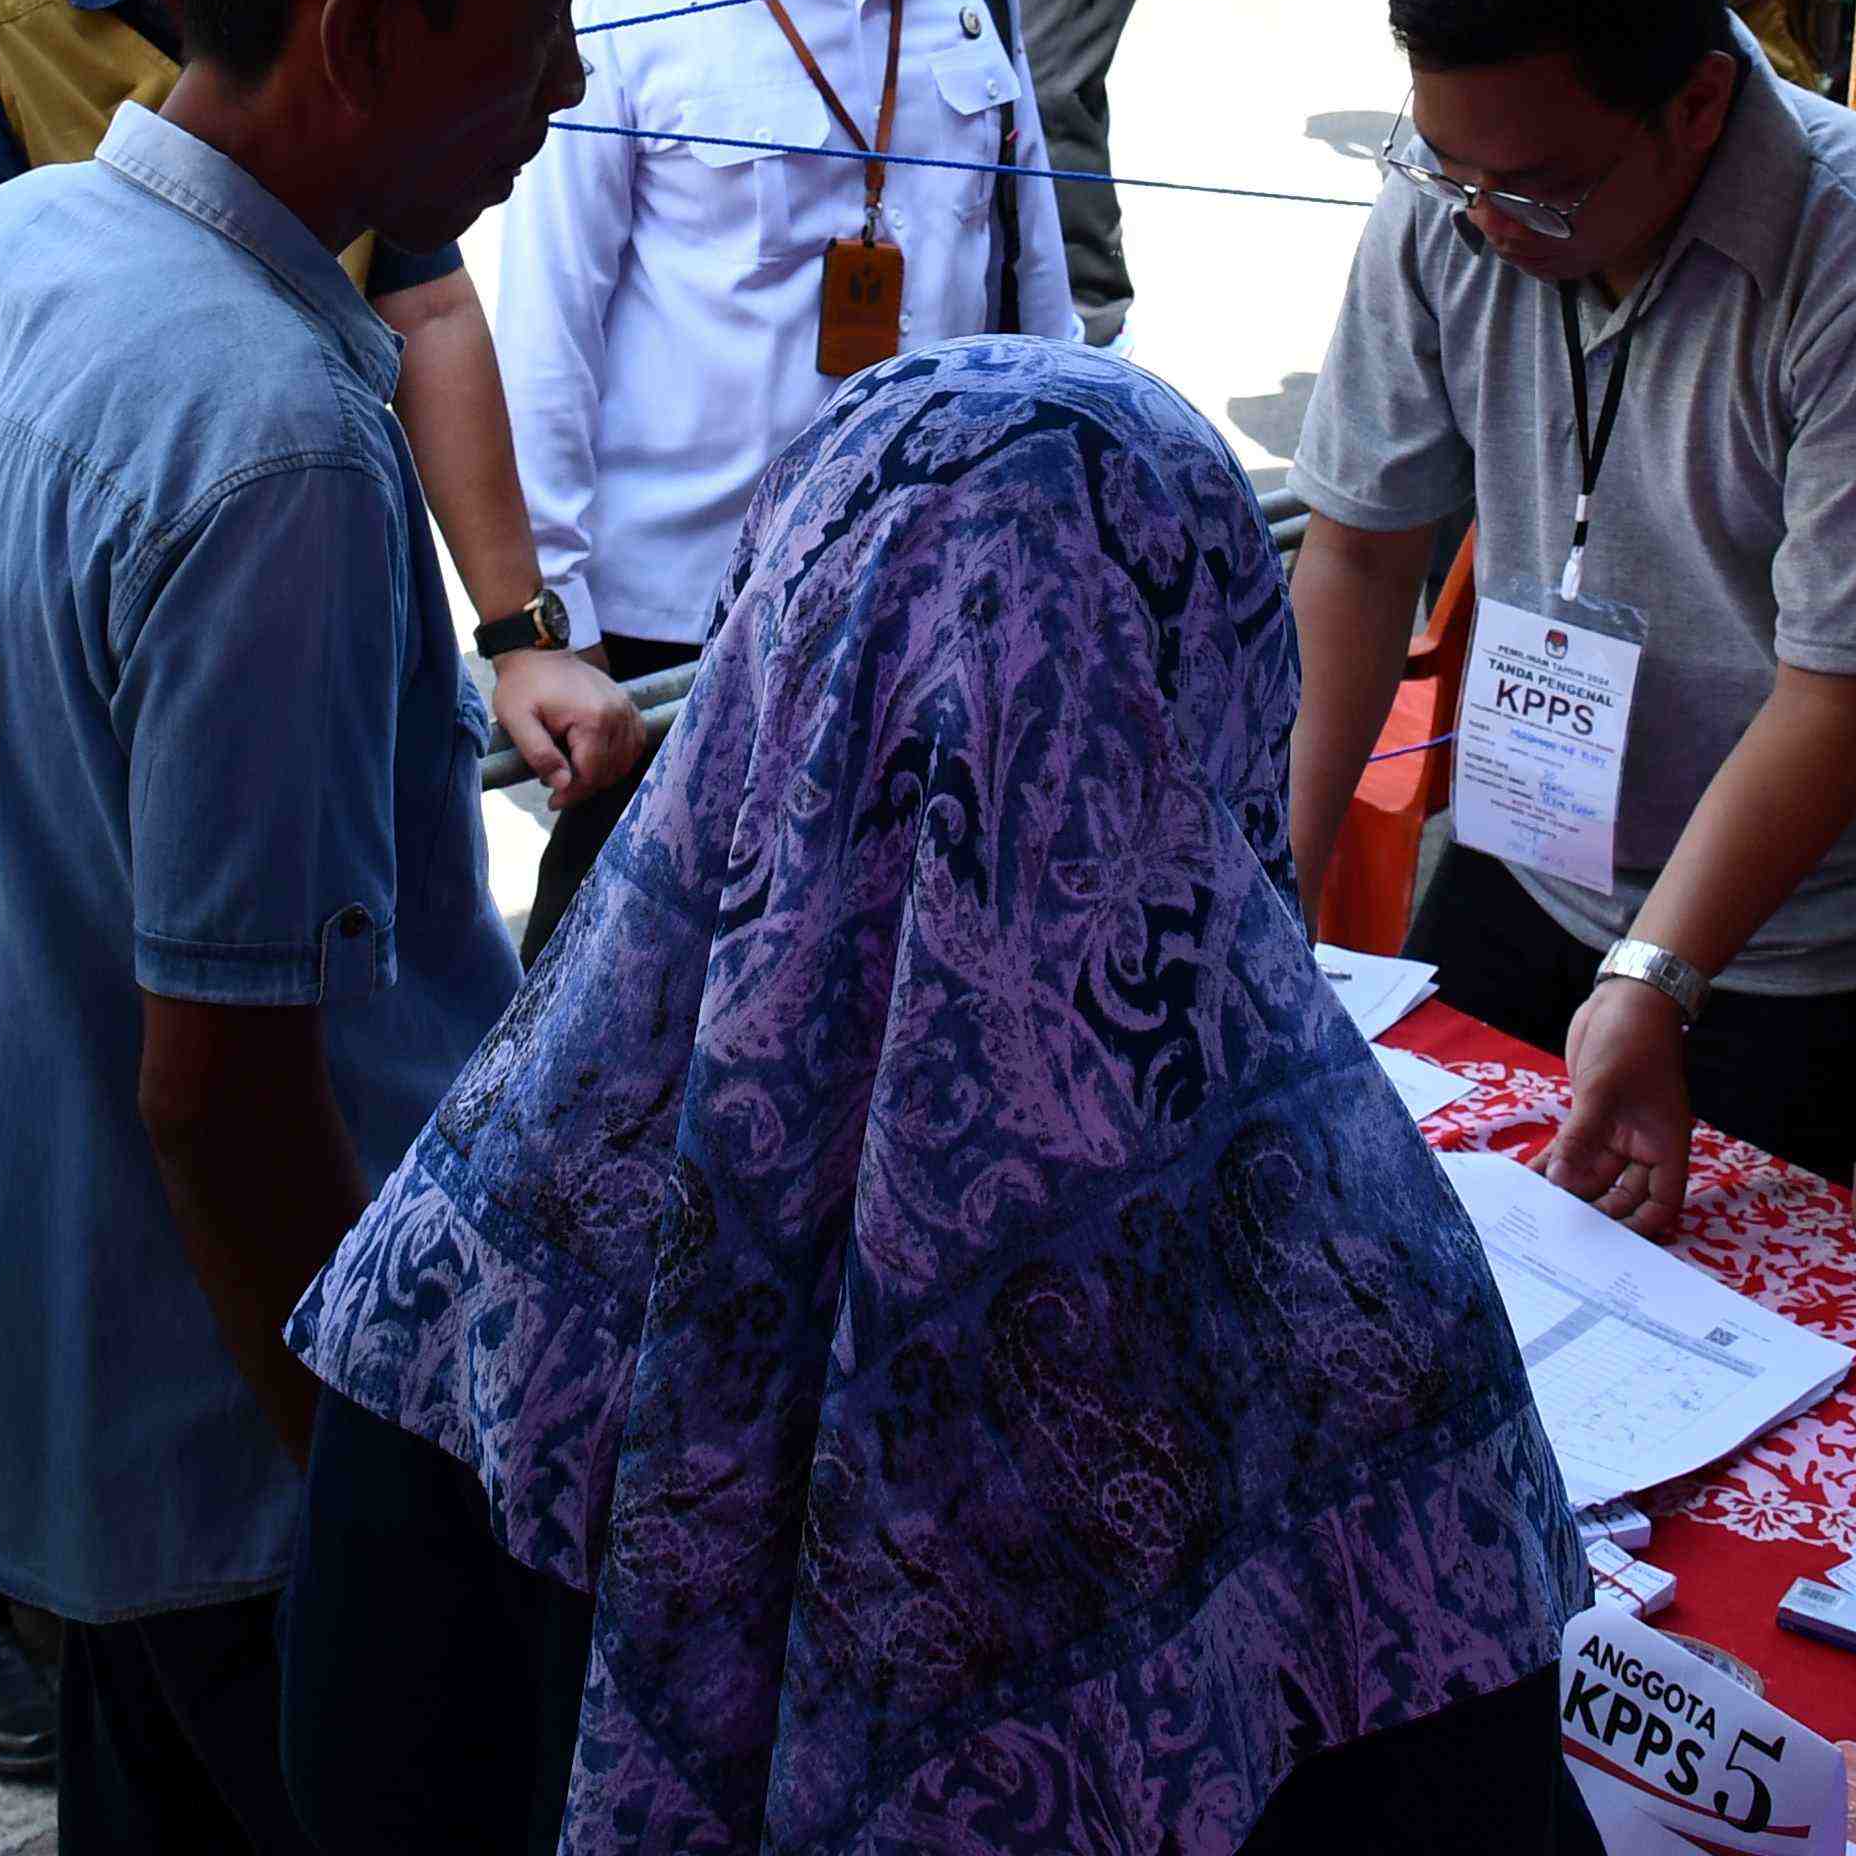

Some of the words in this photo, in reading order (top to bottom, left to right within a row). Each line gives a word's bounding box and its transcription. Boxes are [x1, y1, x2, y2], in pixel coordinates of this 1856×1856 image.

[1488, 657, 1534, 681] TANDA
[1537, 675, 1615, 708] PENGENAL
[1495, 678, 1595, 736] KPPS
[1578, 1634, 1718, 1740] ANGGOTA
[1562, 1669, 1706, 1796] KPPS
[1713, 1728, 1787, 1834] 5
